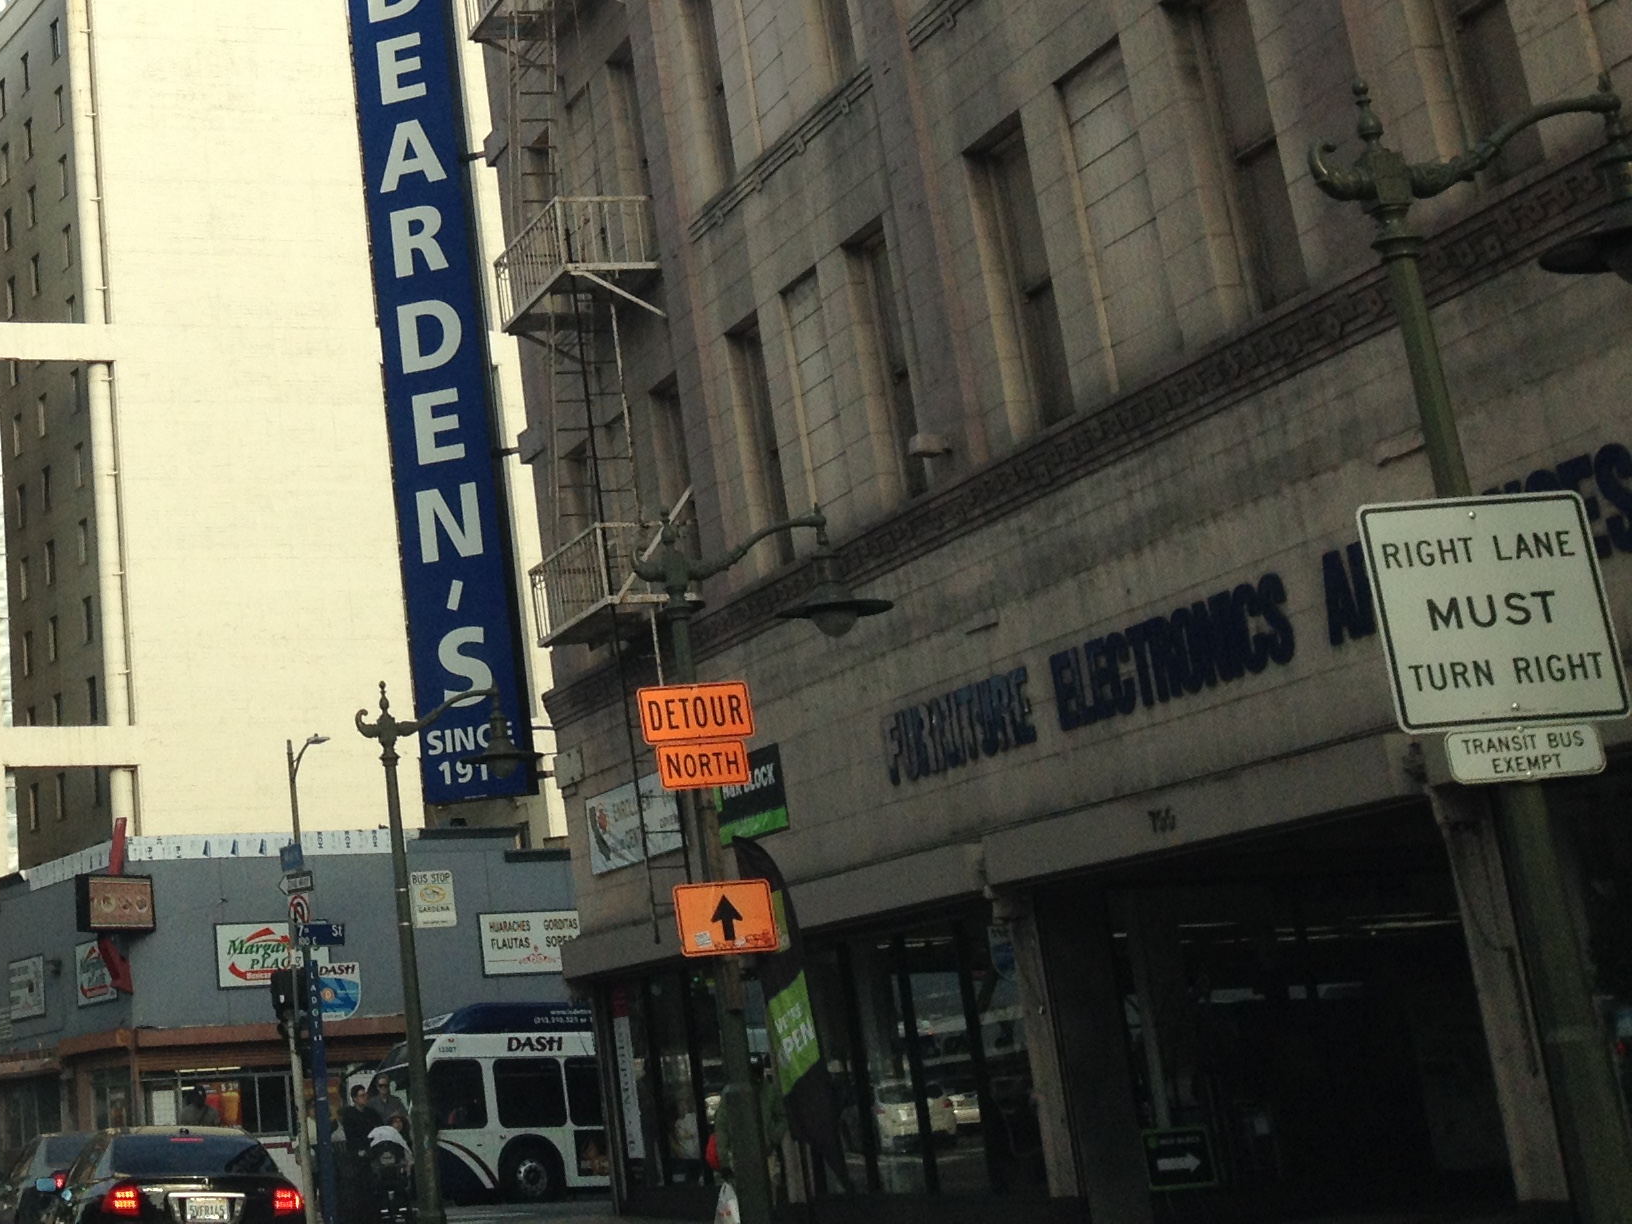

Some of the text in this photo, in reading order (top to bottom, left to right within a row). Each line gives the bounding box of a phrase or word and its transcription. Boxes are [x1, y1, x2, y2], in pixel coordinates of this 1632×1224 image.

[1382, 530, 1576, 569] RIGHT LANE
[1426, 590, 1556, 631] MUST
[1048, 573, 1296, 732] ELECTRONICS
[1409, 651, 1604, 692] TURN RIGHT
[648, 694, 744, 731] DETOUR
[426, 721, 515, 756] SINC
[1461, 730, 1585, 755] TRANSIT BUS
[666, 751, 740, 779] NORTH
[1491, 753, 1564, 775] EXEMPT
[412, 872, 451, 884] BUS STOP
[331, 924, 343, 937] St
[488, 918, 578, 933] HUARACHES GORDITAS
[491, 936, 531, 950] FLAUTAS
[250, 957, 292, 970] PLAC
[319, 964, 356, 976] DASH
[507, 1036, 564, 1052] DASH
